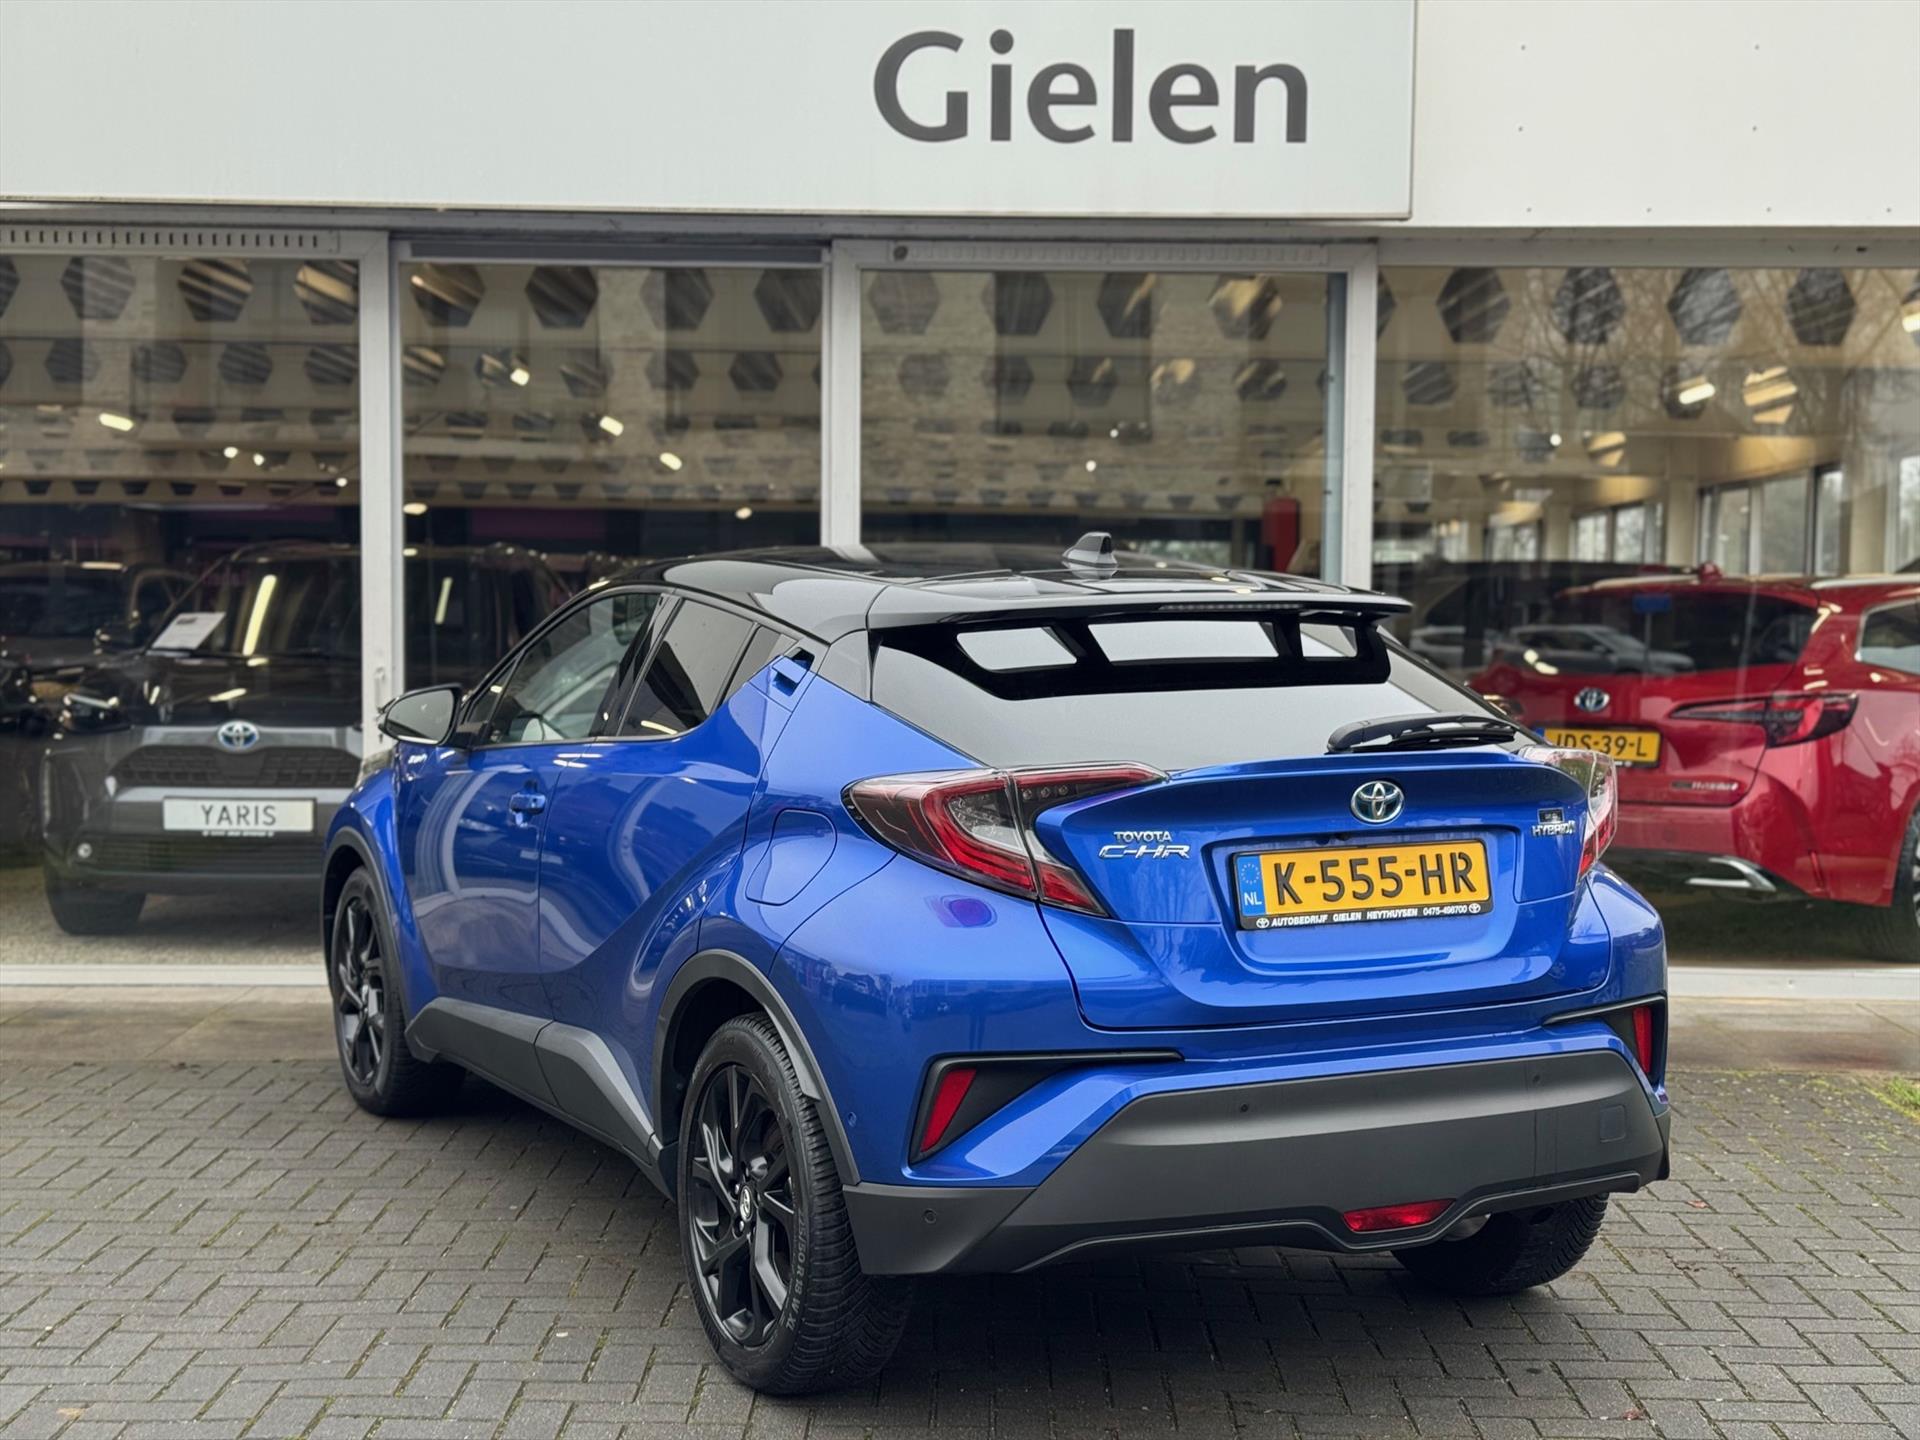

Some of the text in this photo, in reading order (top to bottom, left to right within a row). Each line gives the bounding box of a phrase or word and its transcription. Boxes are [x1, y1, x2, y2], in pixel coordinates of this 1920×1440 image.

[873, 28, 1308, 145] Gielen
[201, 804, 277, 827] YARIS
[1113, 830, 1173, 843] TOYOTA
[1098, 844, 1191, 859] C-HR
[1273, 851, 1478, 906] K-555-HR
[1243, 892, 1263, 906] NL
[1271, 914, 1328, 927] AUTOBEDRIJF
[1333, 911, 1362, 922] GIELEN
